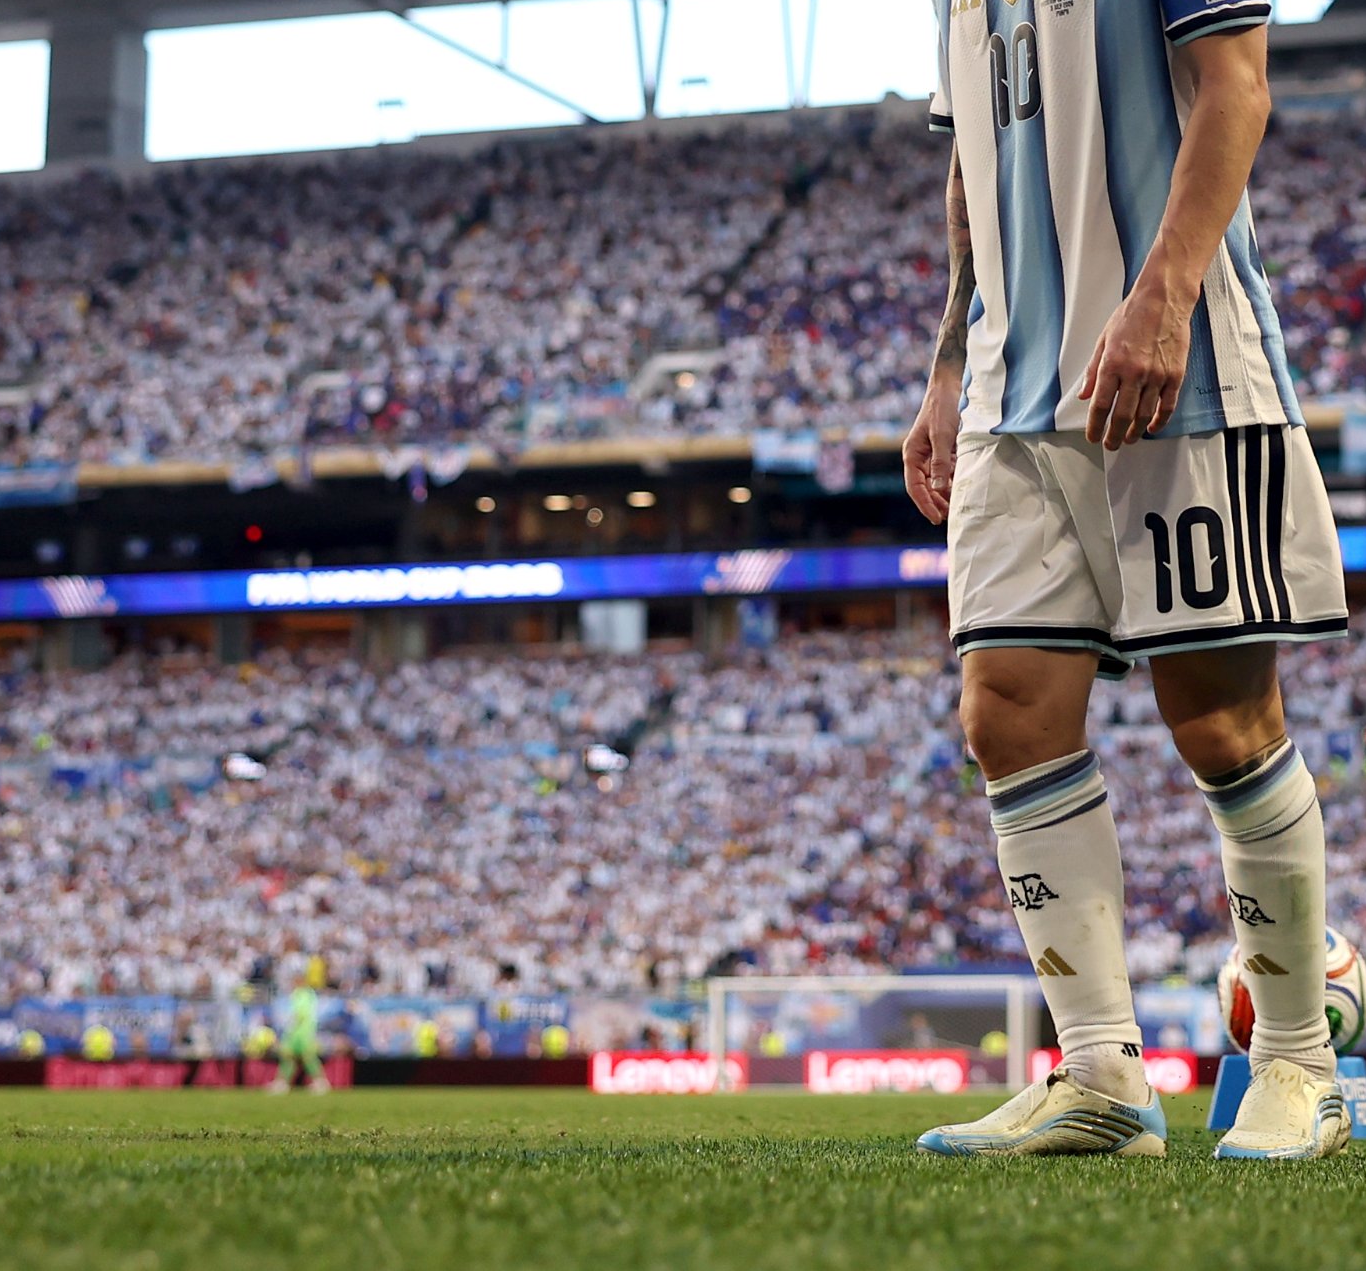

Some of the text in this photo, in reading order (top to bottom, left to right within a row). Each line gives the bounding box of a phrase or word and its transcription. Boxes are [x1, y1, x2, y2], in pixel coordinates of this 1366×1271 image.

[990, 22, 1043, 129] 10
[1145, 506, 1229, 613] 10
[1009, 873, 1059, 912] AFA
[808, 1050, 964, 1093] Lenovo
